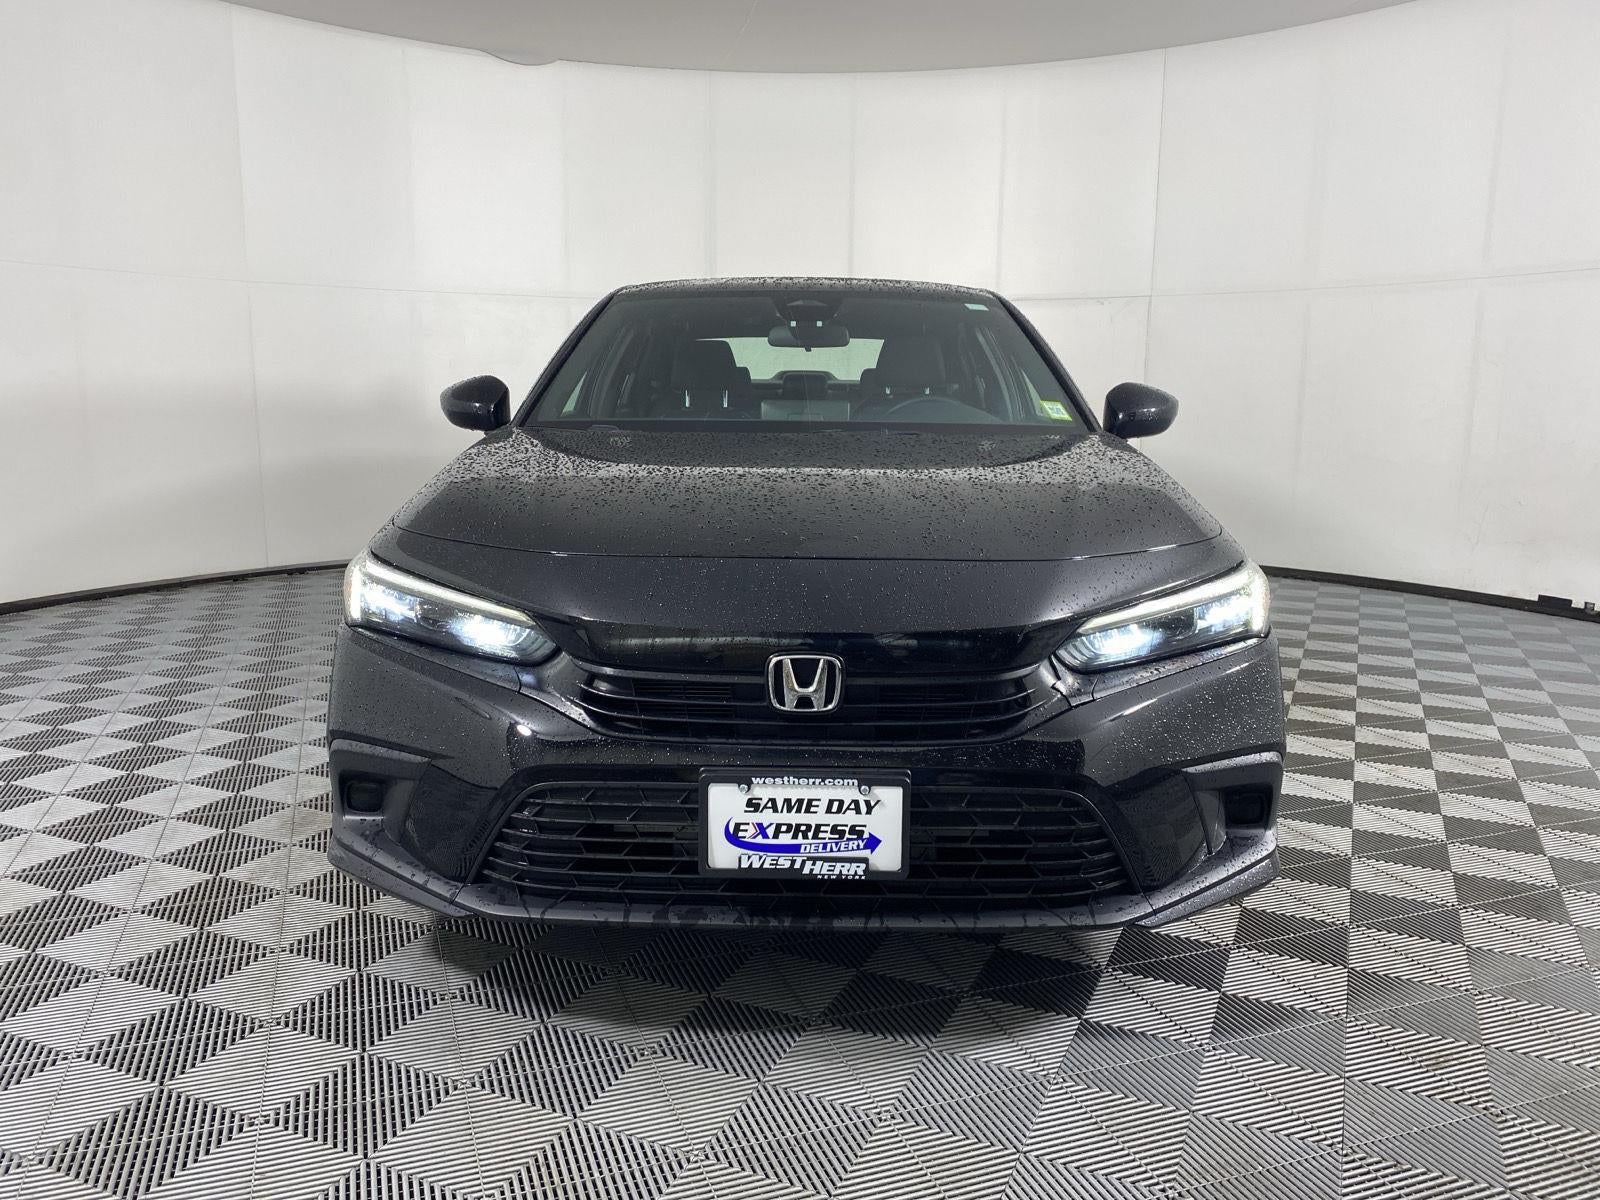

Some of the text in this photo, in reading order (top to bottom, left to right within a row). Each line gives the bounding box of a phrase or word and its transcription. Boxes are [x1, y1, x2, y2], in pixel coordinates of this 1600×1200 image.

[751, 776, 858, 786] westherr.com
[744, 797, 881, 815] SAME DAY
[732, 822, 867, 840] EXPRESS
[800, 839, 867, 854] DELIVERY
